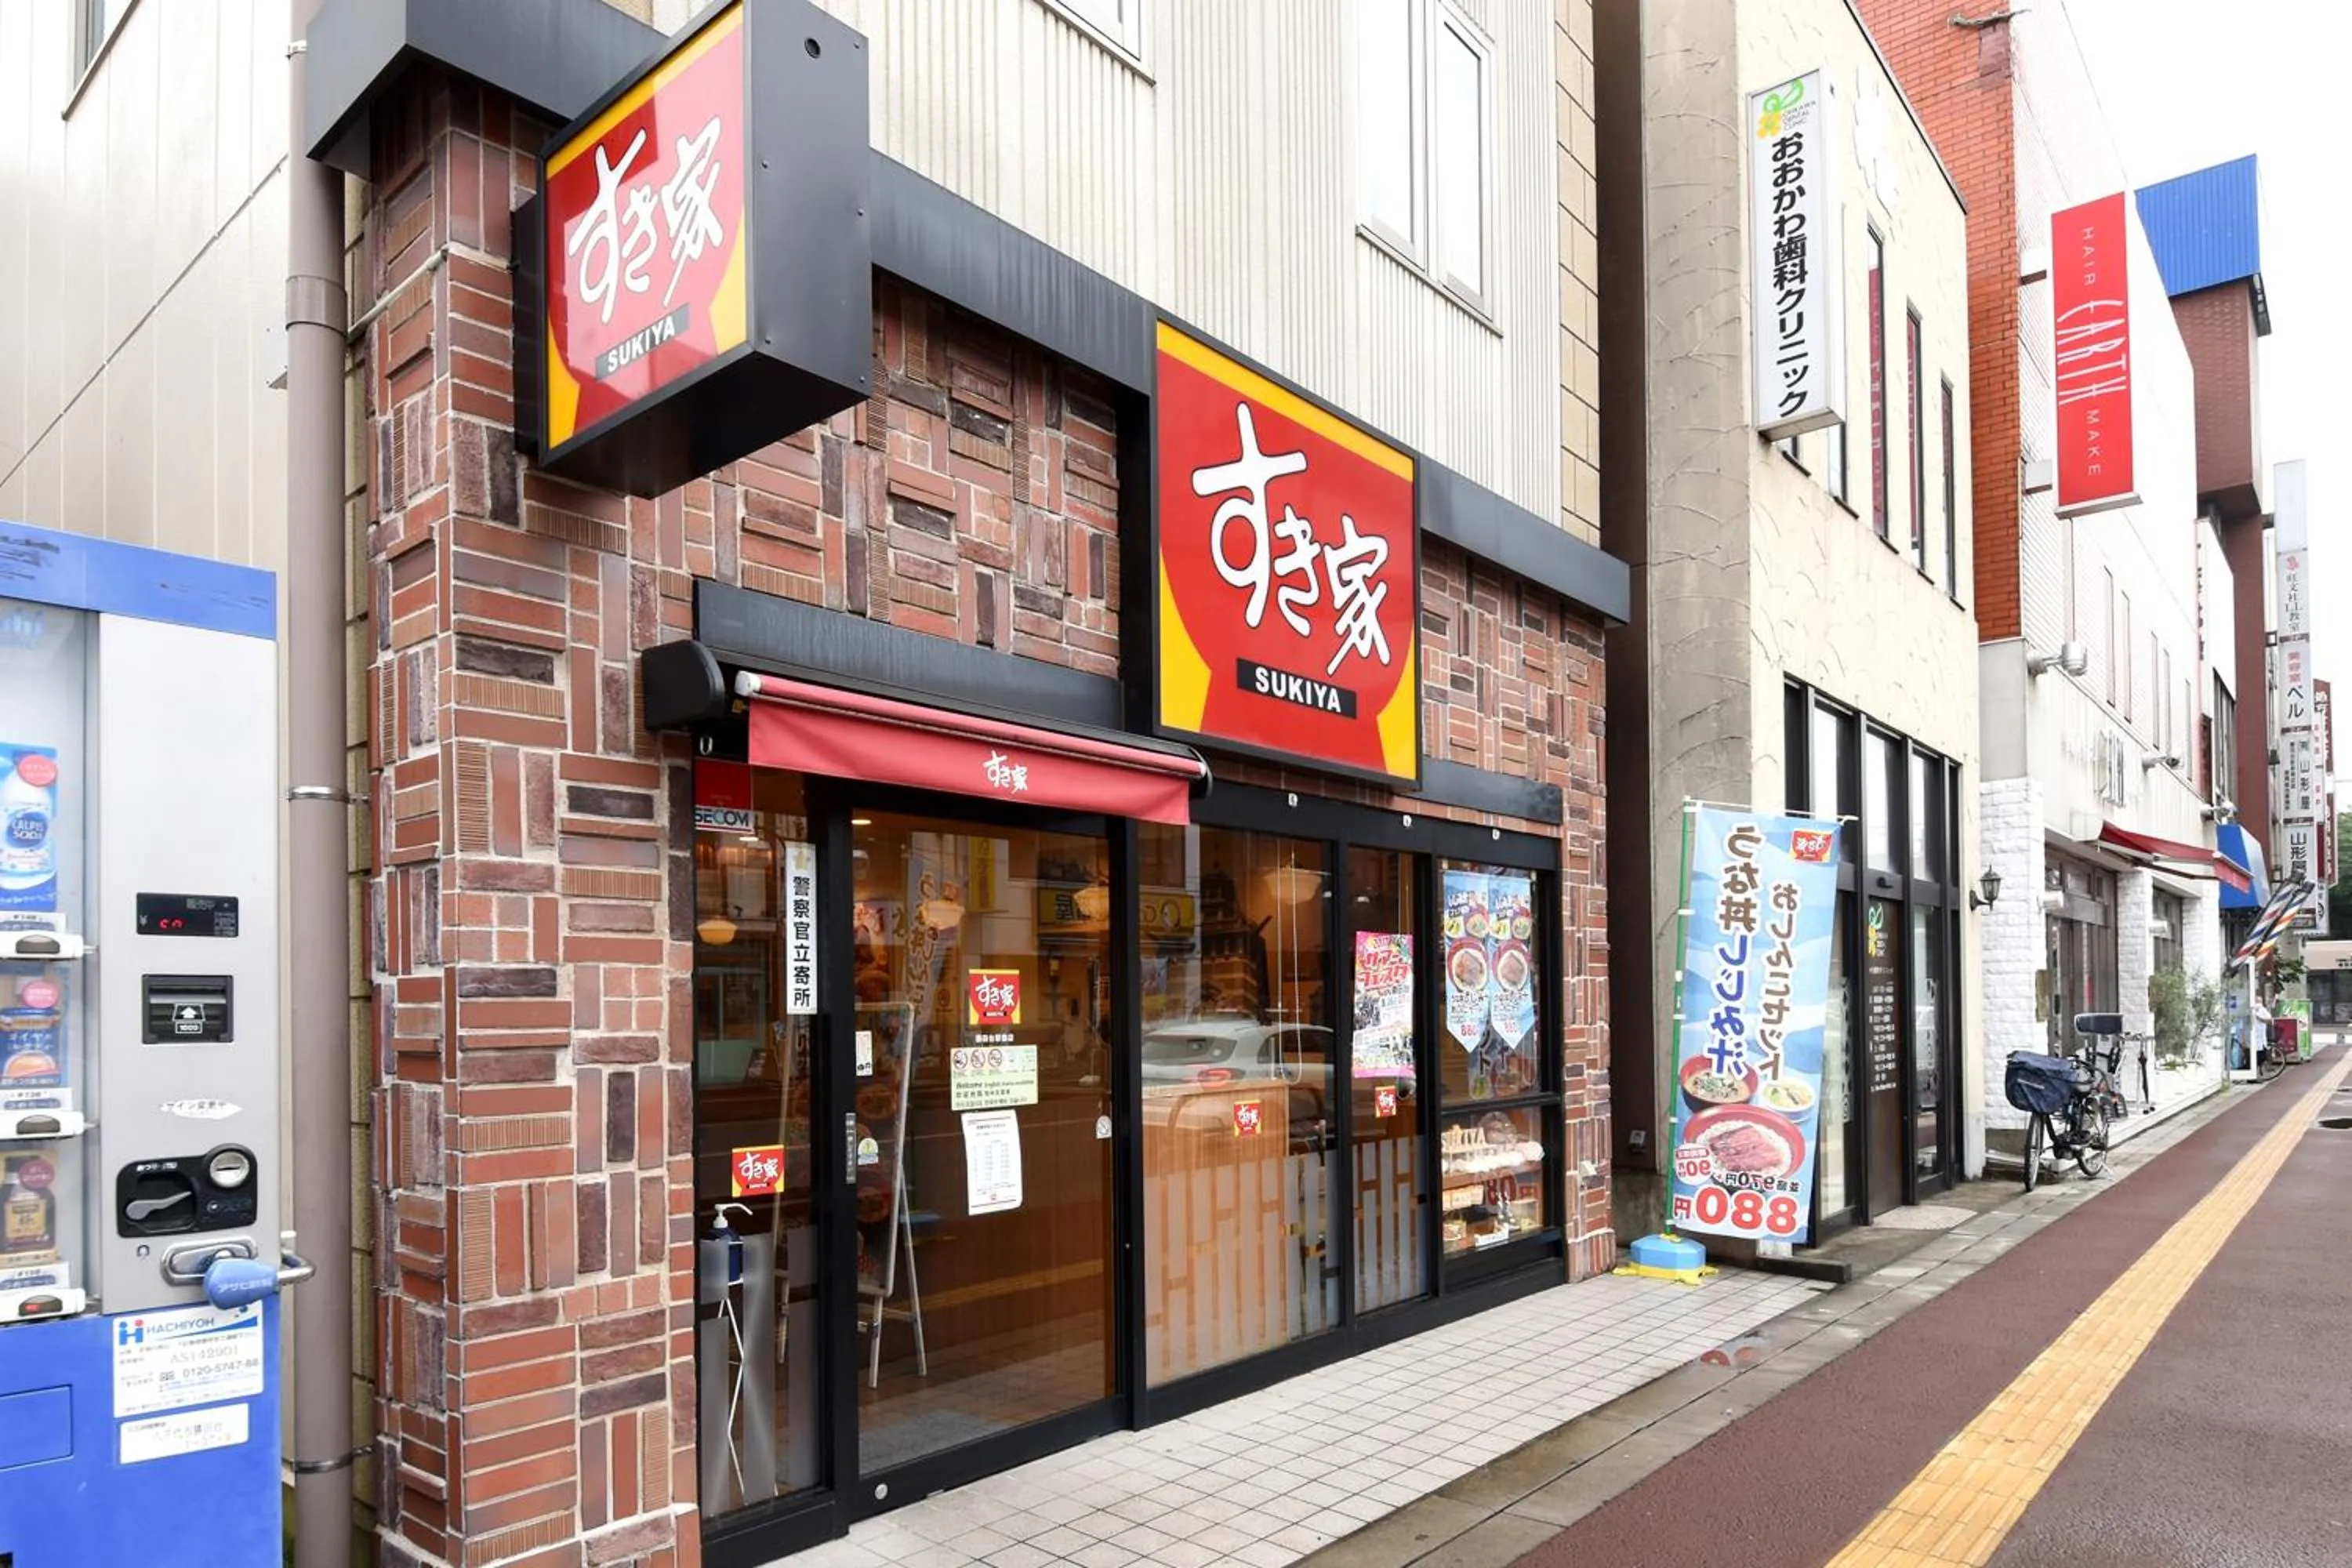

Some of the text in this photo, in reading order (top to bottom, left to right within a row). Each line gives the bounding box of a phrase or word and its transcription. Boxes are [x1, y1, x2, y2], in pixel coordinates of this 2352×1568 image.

[568, 115, 723, 324] すき家
[1772, 131, 1809, 417] おおかわ歯科クリニック
[2082, 227, 2096, 286] HAIR
[607, 316, 676, 373] SUKIYA
[2085, 409, 2101, 476] MAKE
[1192, 401, 1391, 677] すき家
[1255, 666, 1341, 713] SUKIYA
[2287, 685, 2304, 718] ベル
[982, 750, 1028, 794] すき家
[695, 808, 750, 827] SECOM
[793, 876, 811, 1007] 警察官立寄所
[975, 975, 1014, 1011] すき家
[738, 1152, 779, 1182] すき家
[147, 1317, 215, 1335] HACHIYOH
